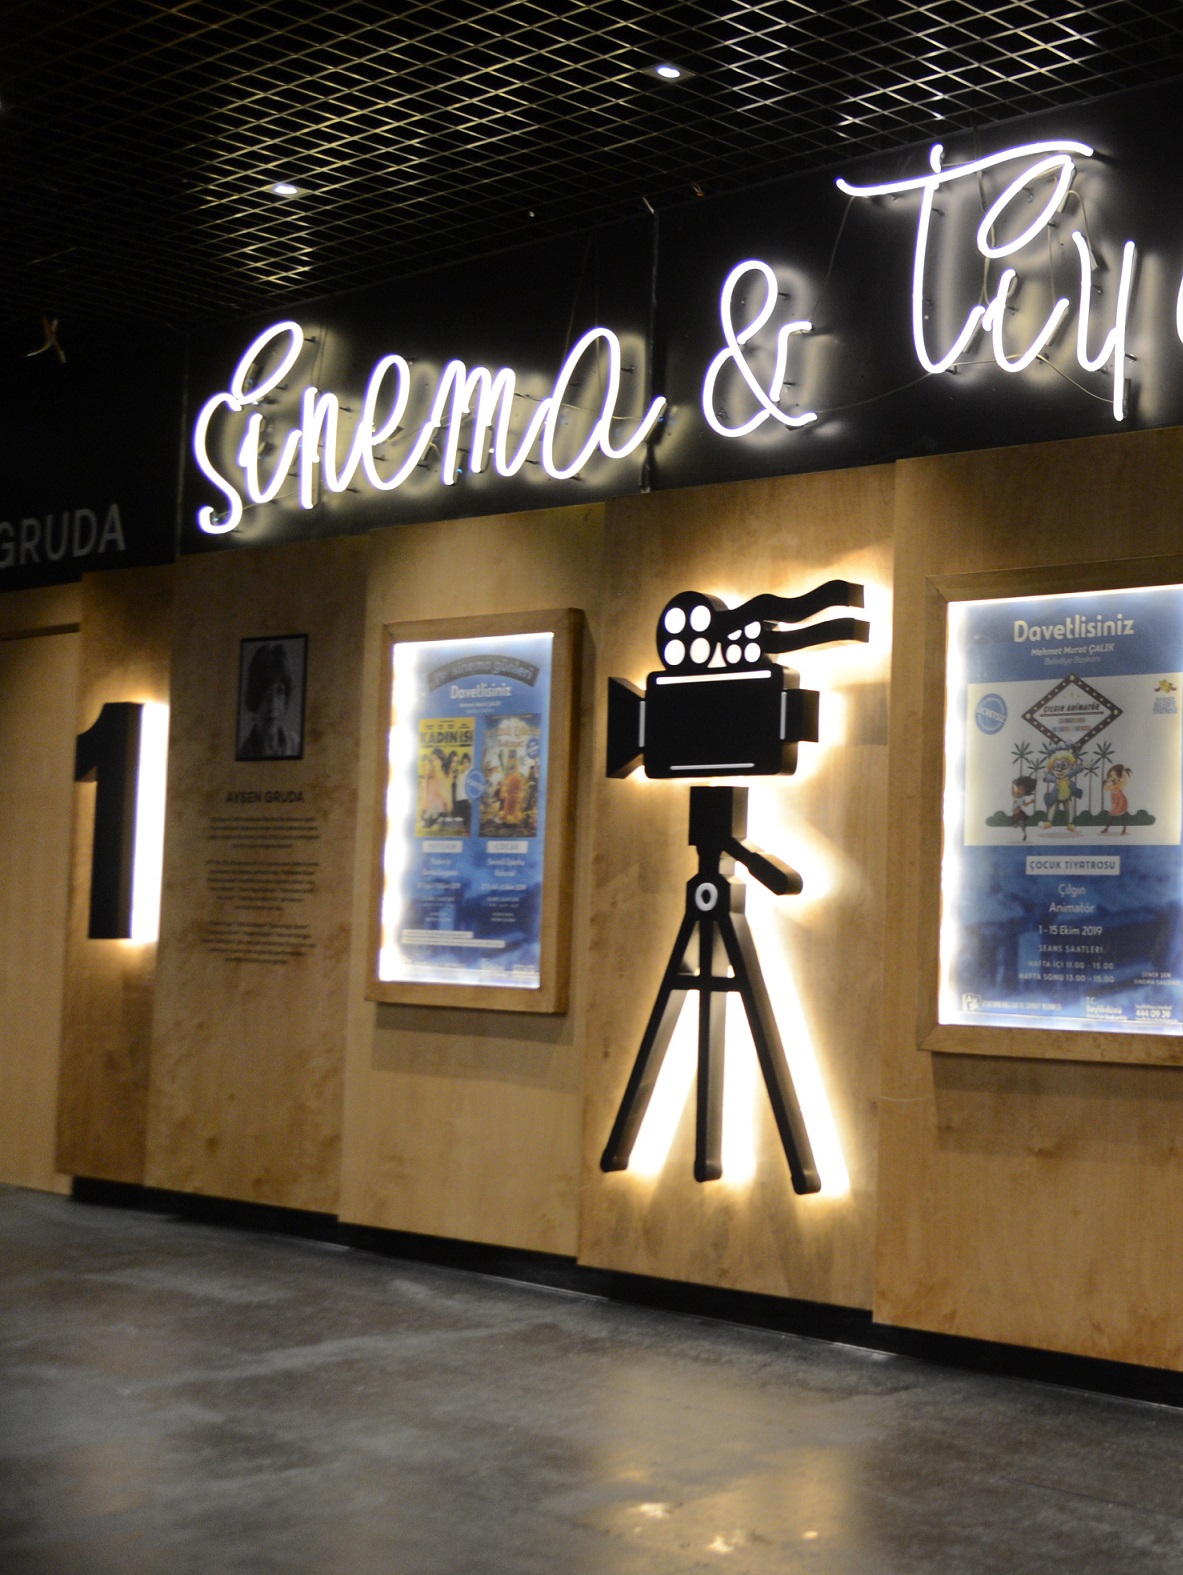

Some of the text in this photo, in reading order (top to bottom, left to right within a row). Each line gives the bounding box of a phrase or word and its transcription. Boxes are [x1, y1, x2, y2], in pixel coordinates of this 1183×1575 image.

[194, 320, 667, 534] Sinema
[703, 258, 818, 438] &
[0, 503, 126, 569] GRUDA
[1013, 613, 1135, 643] Davetlisiniz
[75, 701, 145, 940] 1
[1029, 859, 1116, 872] ÇOCUK TİYATROSU
[1048, 902, 1096, 913] Animatör
[1049, 926, 1058, 934] 15
[1060, 925, 1080, 935] Ekim
[1082, 926, 1103, 936] 2019
